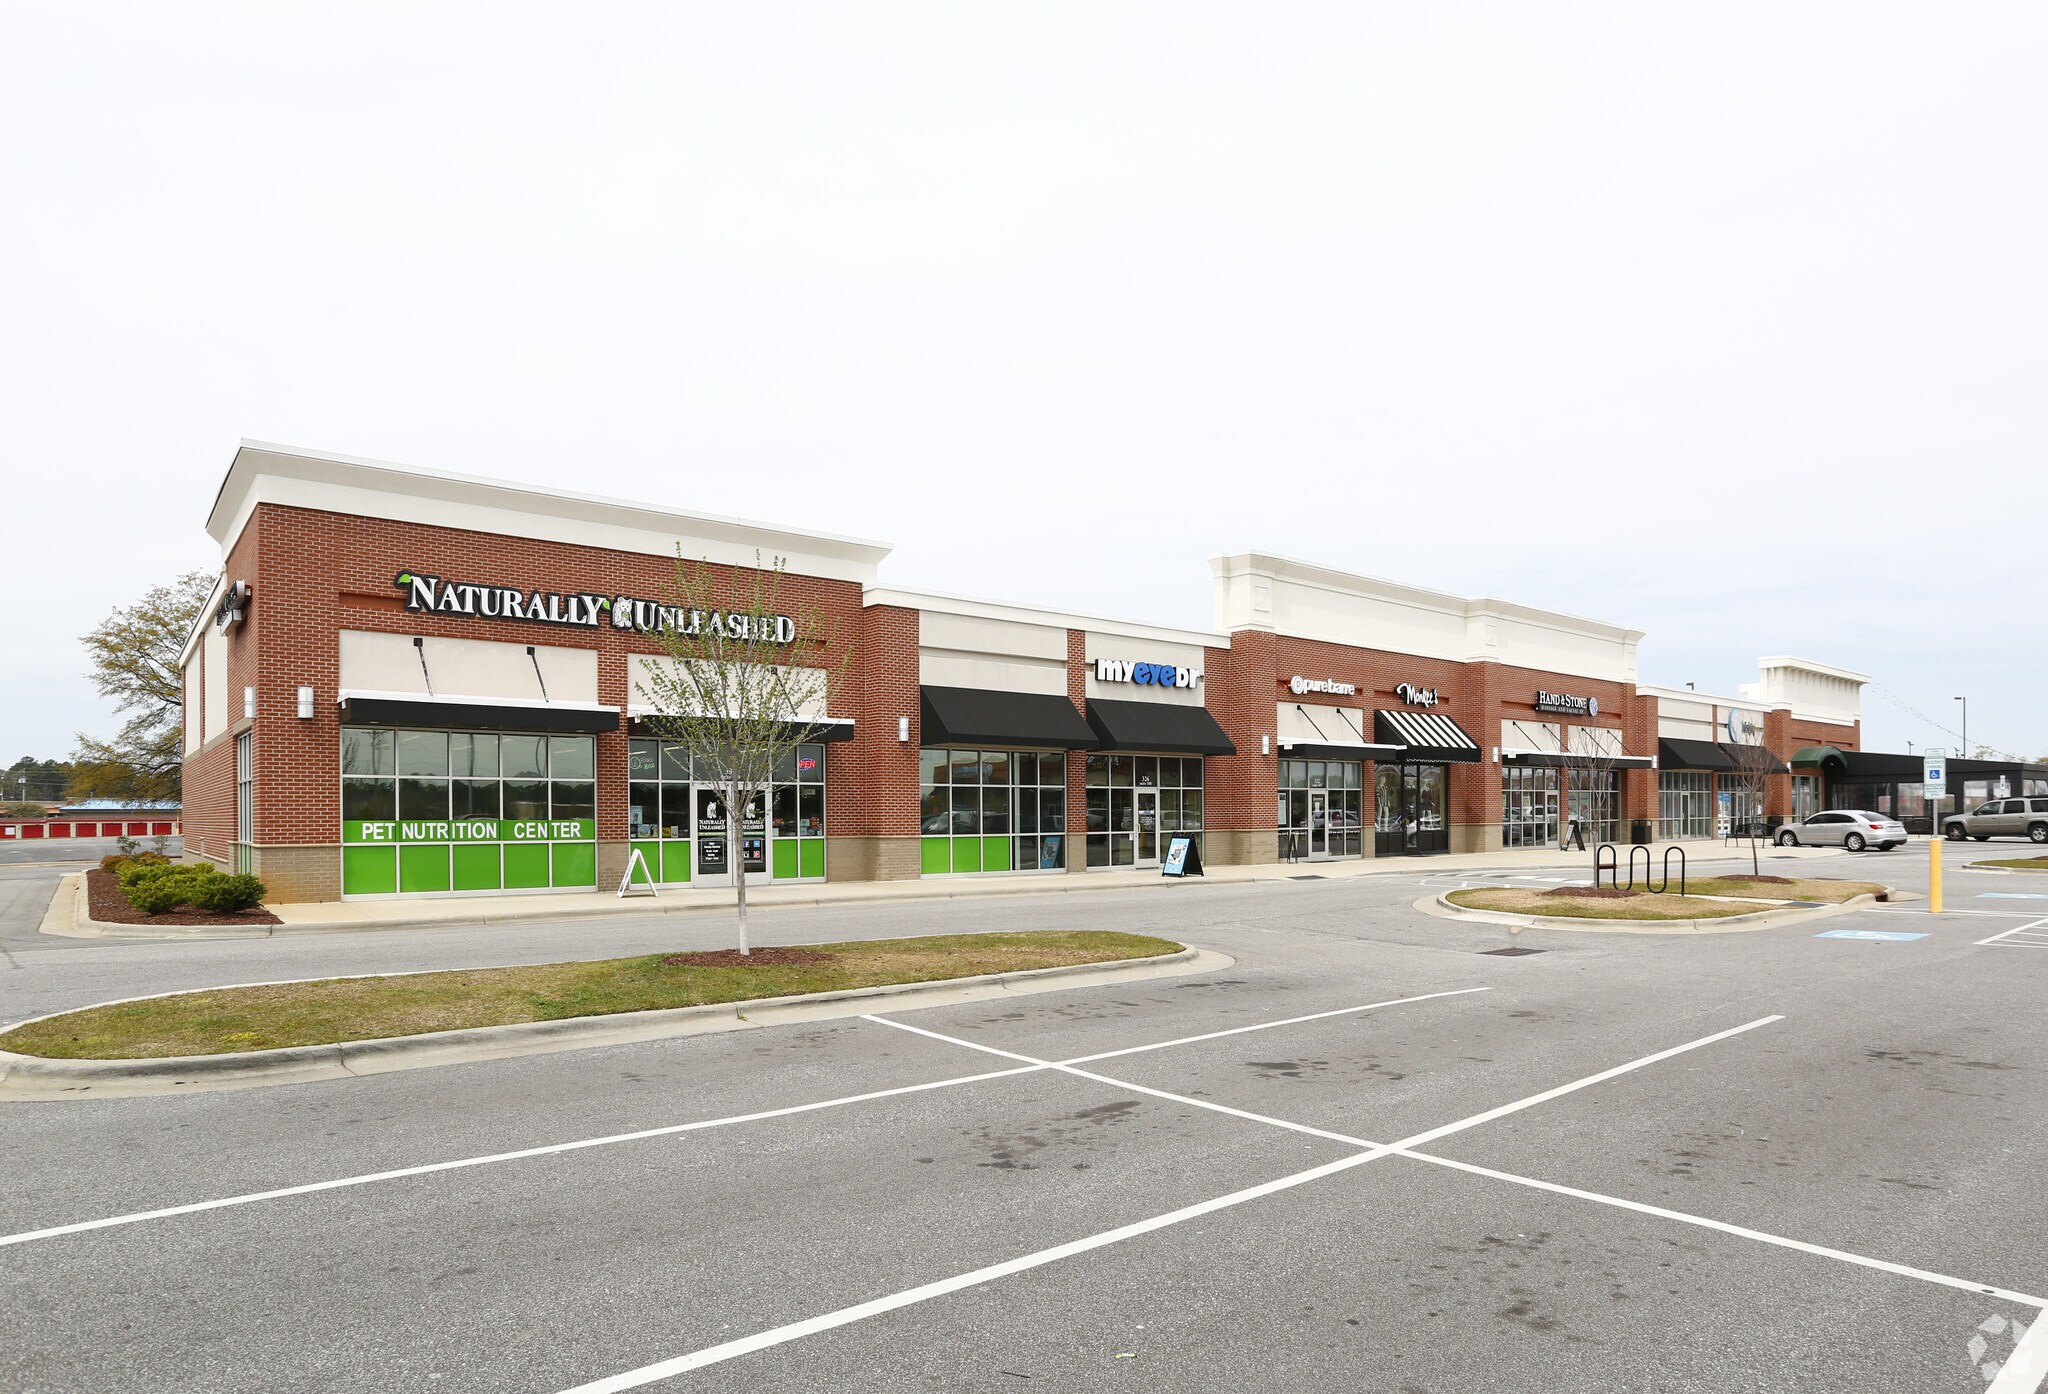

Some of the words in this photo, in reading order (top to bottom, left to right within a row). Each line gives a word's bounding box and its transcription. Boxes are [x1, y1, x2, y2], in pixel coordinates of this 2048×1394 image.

[408, 575, 606, 626] NATURALLY
[798, 760, 816, 769] PEN
[361, 822, 396, 840] PET
[513, 821, 582, 839] CENTER
